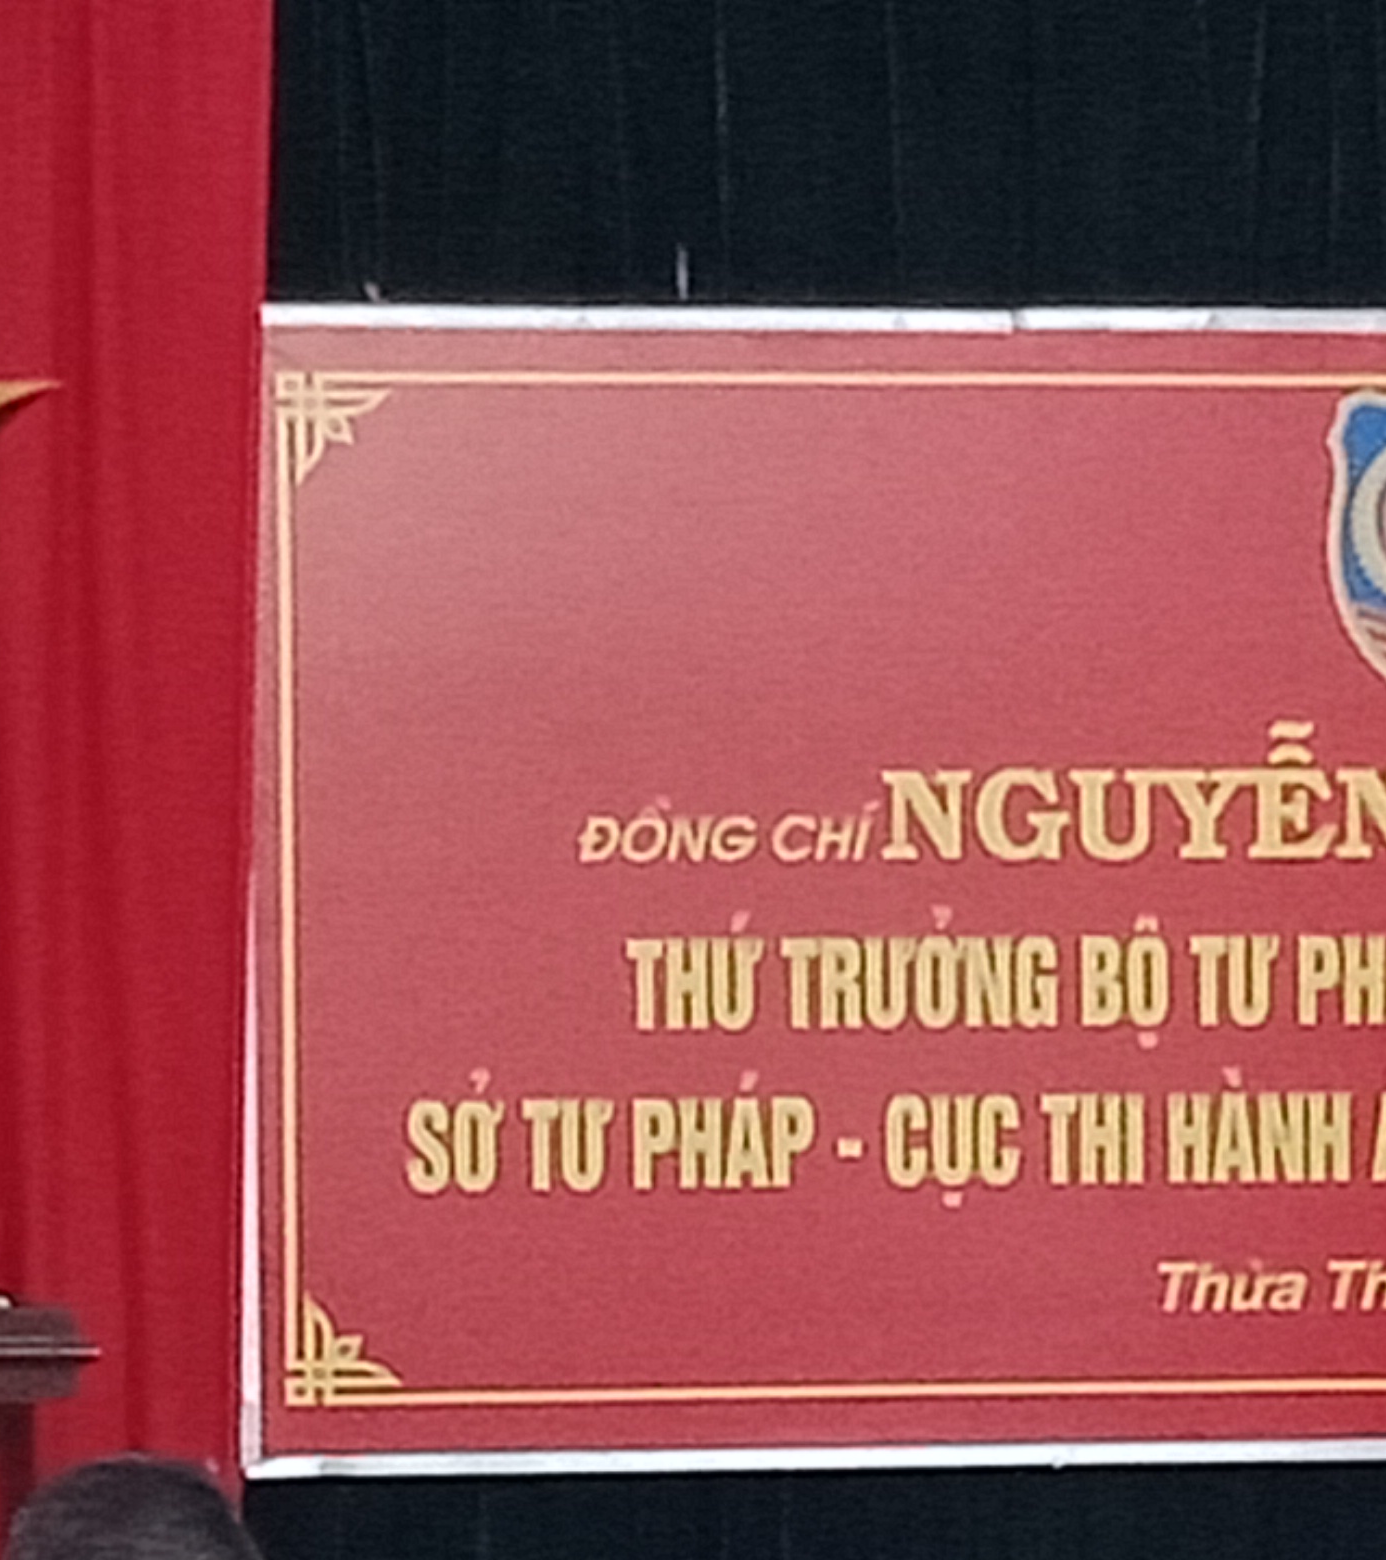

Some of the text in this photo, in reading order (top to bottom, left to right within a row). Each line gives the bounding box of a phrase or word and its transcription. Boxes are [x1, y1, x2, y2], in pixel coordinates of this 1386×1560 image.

[577, 795, 759, 864] ĐỒNG
[770, 799, 882, 864] CHÍ
[625, 911, 767, 1032] THỨ
[779, 905, 1061, 1031] TRƯỞNG
[1079, 913, 1171, 1050] BỘ
[1188, 932, 1282, 1028] TƯ
[405, 1067, 507, 1195] SỞ
[521, 1096, 616, 1193] TƯ
[631, 1070, 816, 1191] PHÁP
[836, 1136, 864, 1159] -
[884, 1092, 1023, 1209] CỤC
[1040, 1090, 1146, 1186] THI
[1167, 1066, 1353, 1185] HÀNH
[1155, 1256, 1309, 1314] Thừa
